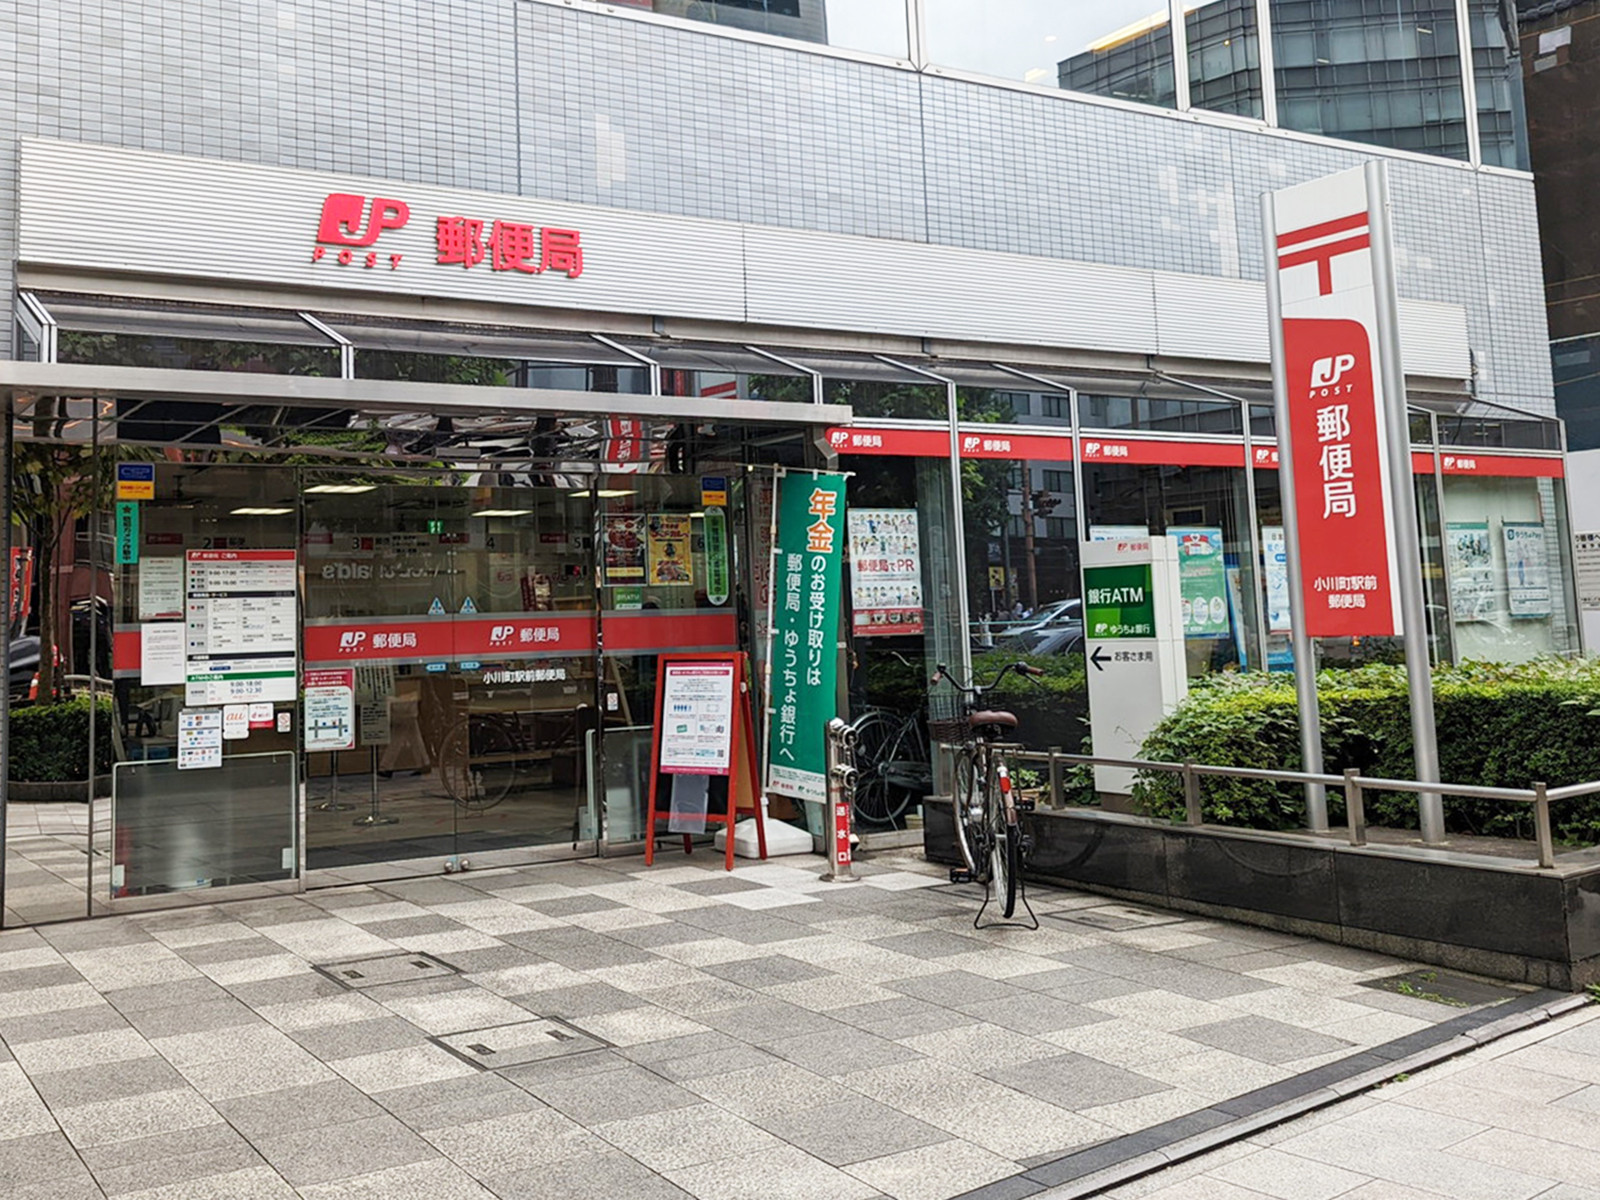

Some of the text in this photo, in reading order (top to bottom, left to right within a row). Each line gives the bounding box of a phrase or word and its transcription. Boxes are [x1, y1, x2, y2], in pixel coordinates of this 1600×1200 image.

[436, 216, 584, 279] 郵便局
[312, 246, 403, 269] POST
[1309, 385, 1353, 399] POST
[852, 434, 882, 447] 郵便局
[983, 440, 1011, 452] 郵便局
[1103, 445, 1128, 457] 郵便局
[1316, 404, 1357, 519] 郵便局
[1456, 459, 1476, 469] 郵便局
[857, 558, 915, 573] 郵便局でPR
[1313, 576, 1378, 592] 小川町駅前
[1087, 587, 1144, 605] 銀行ATM
[1328, 593, 1367, 608] 郵便局
[519, 627, 560, 643] 郵便局
[1110, 623, 1150, 635] ゆうちょ銀行
[372, 632, 417, 649] 郵便局
[1114, 650, 1153, 662] お客さま用
[482, 669, 566, 685] 小川町駅前郵便局
[226, 711, 246, 721] au
